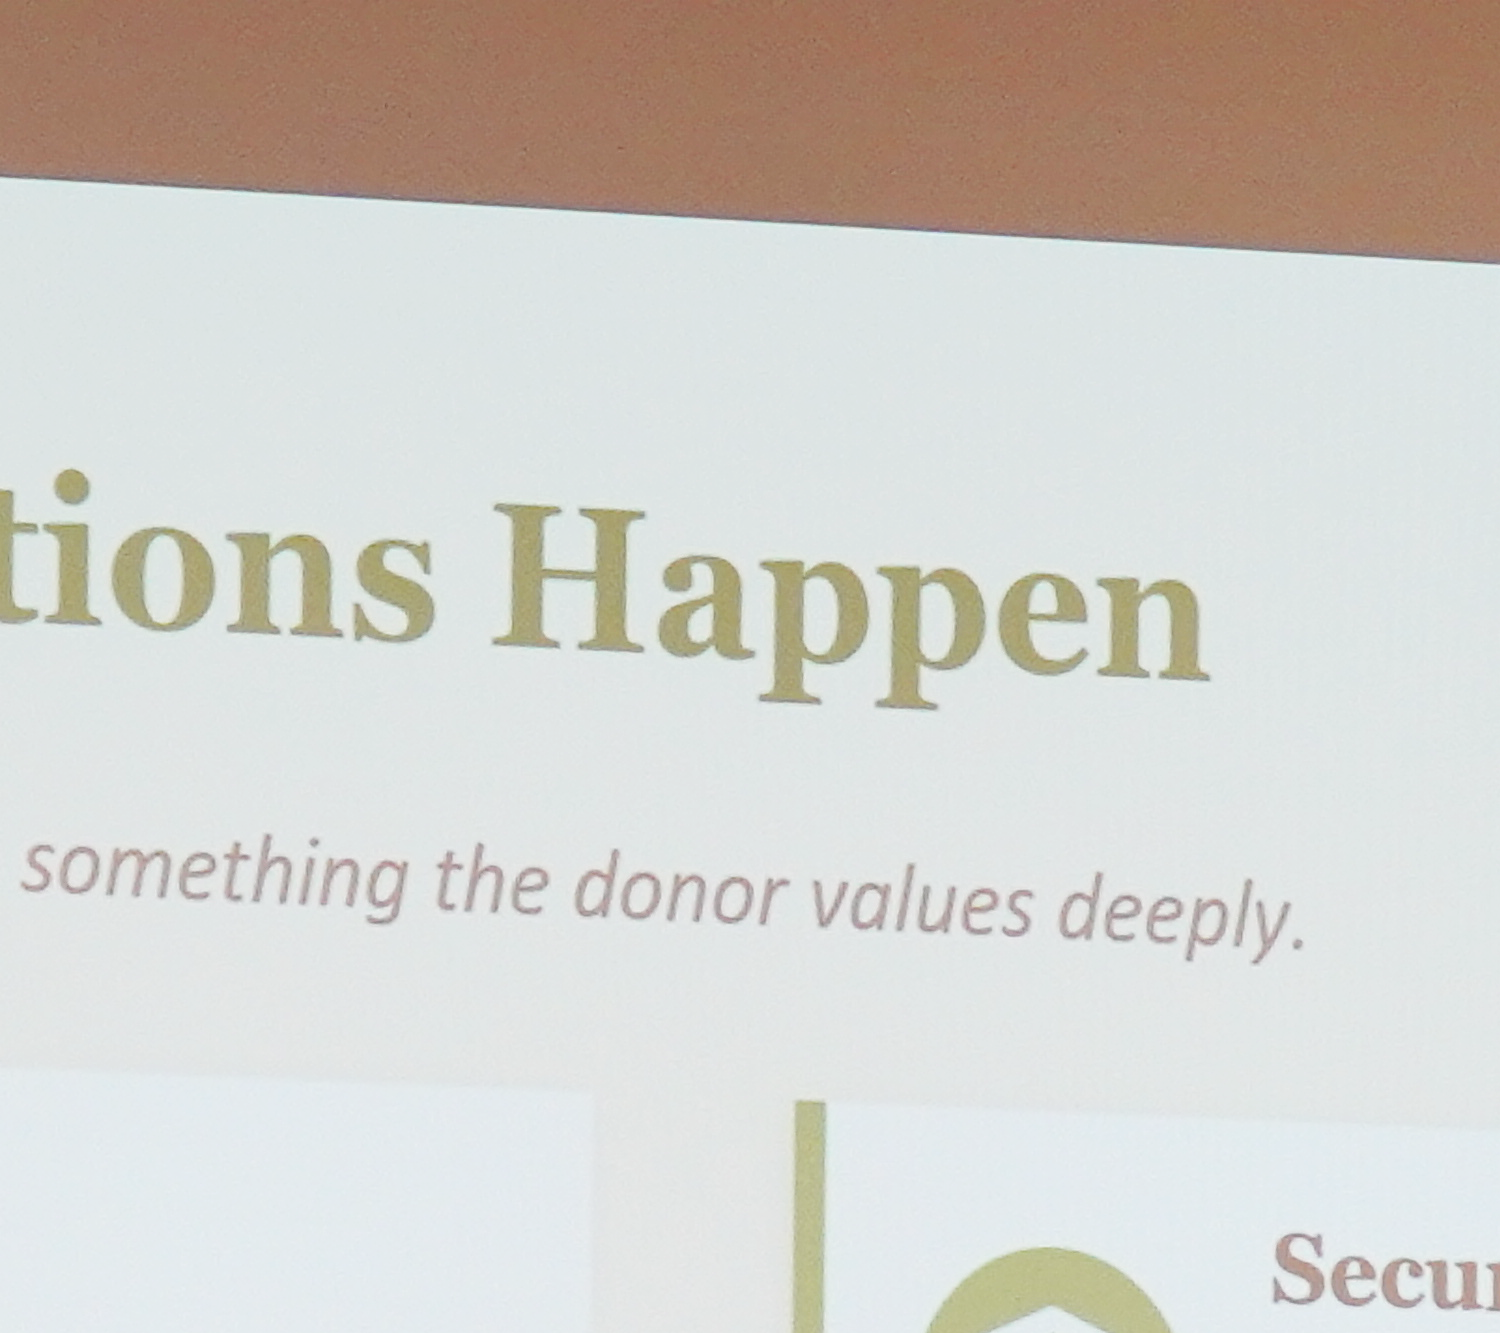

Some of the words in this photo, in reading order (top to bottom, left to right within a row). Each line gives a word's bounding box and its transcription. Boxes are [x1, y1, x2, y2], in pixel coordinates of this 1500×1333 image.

[492, 503, 1212, 711] Happen
[20, 832, 410, 927] something
[435, 841, 551, 916] the
[573, 848, 791, 927] donor
[811, 862, 1035, 939] values
[1058, 870, 1305, 966] deeply.
